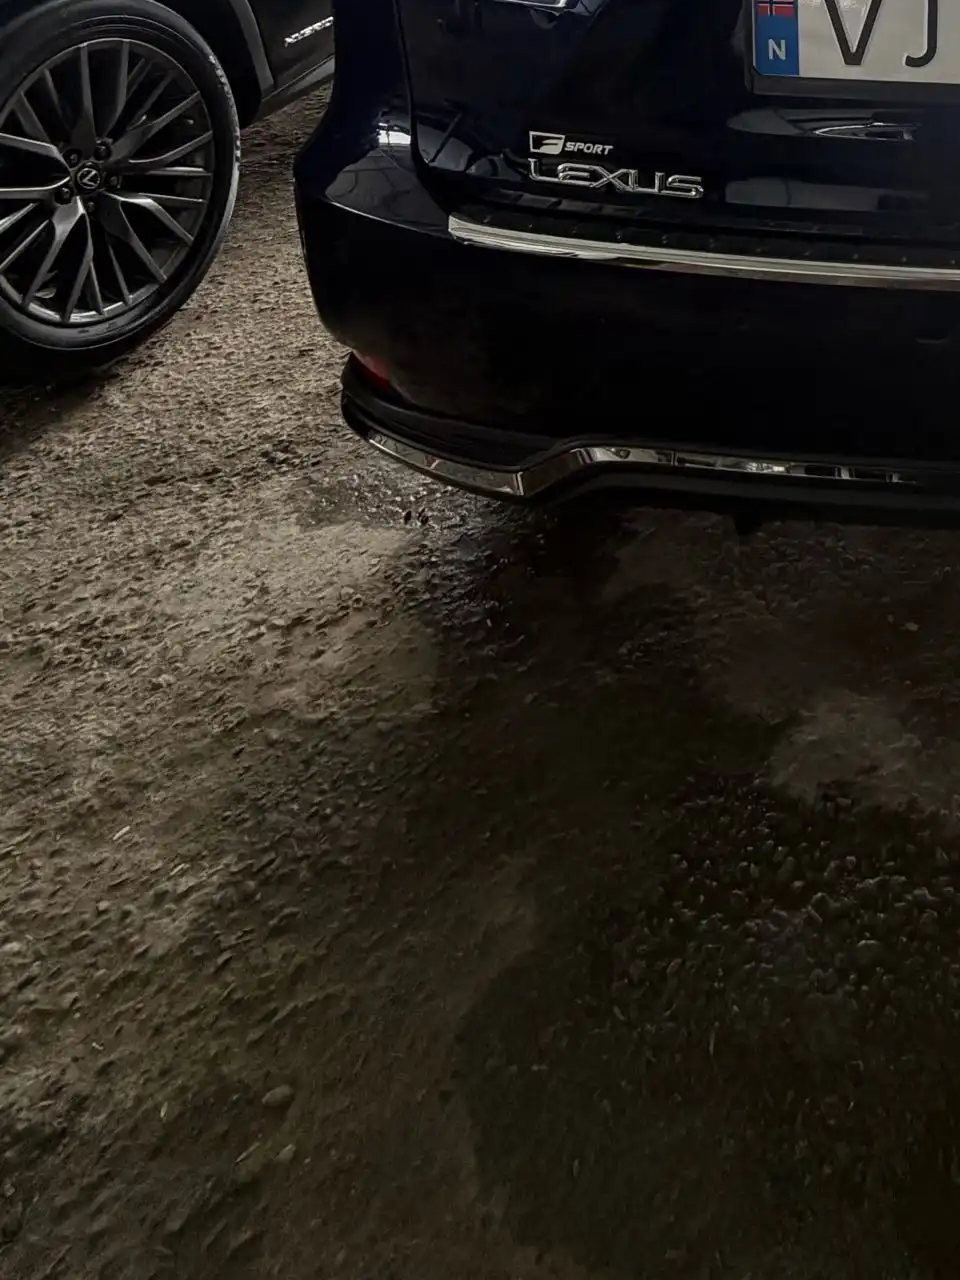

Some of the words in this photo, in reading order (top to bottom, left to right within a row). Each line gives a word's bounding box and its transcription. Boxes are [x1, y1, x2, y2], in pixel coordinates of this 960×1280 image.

[767, 38, 786, 61] N
[564, 141, 613, 155] SPORT
[528, 157, 704, 198] LEXUS
